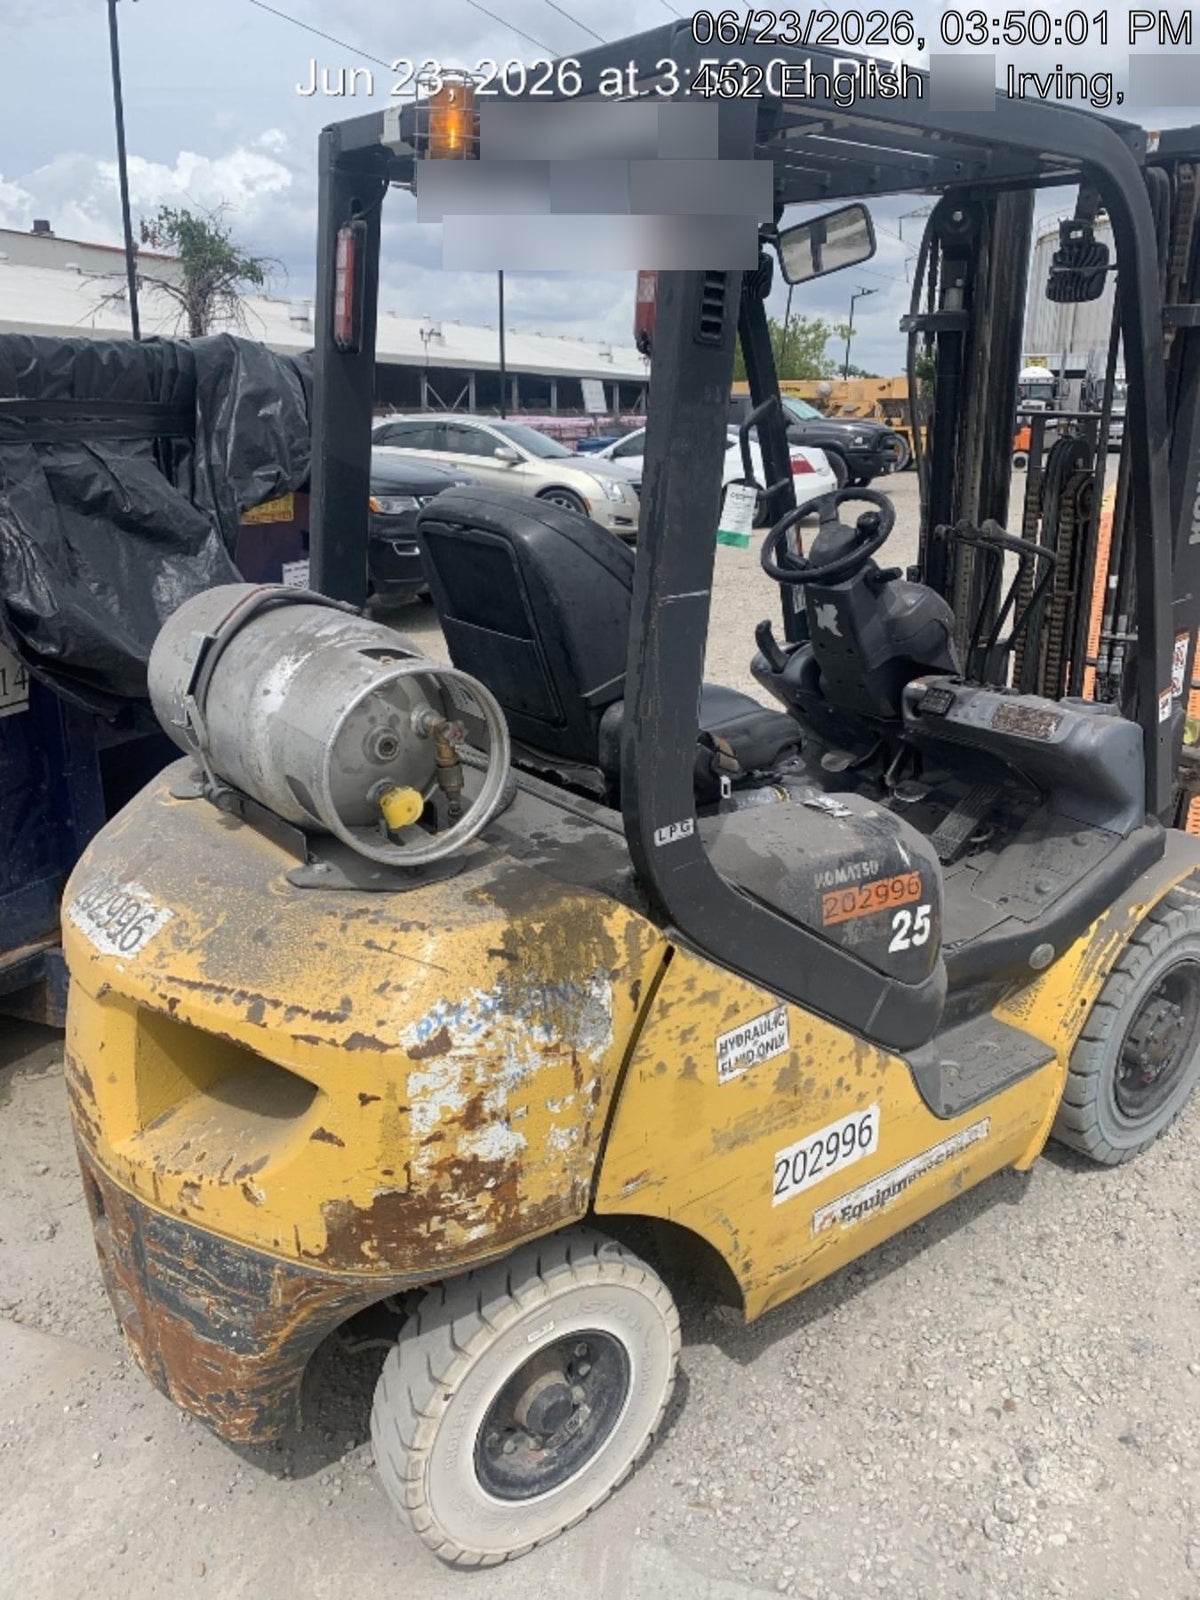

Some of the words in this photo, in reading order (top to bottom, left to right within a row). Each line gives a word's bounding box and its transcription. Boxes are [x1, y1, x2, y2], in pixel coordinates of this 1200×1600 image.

[658, 820, 691, 842] LPG
[813, 860, 879, 890] KOMATSU
[824, 876, 921, 919] 202996
[888, 904, 931, 953] 25
[719, 1013, 786, 1056] HYDRAULIC
[757, 1032, 786, 1059] ONLY
[774, 1114, 873, 1195] 202996
